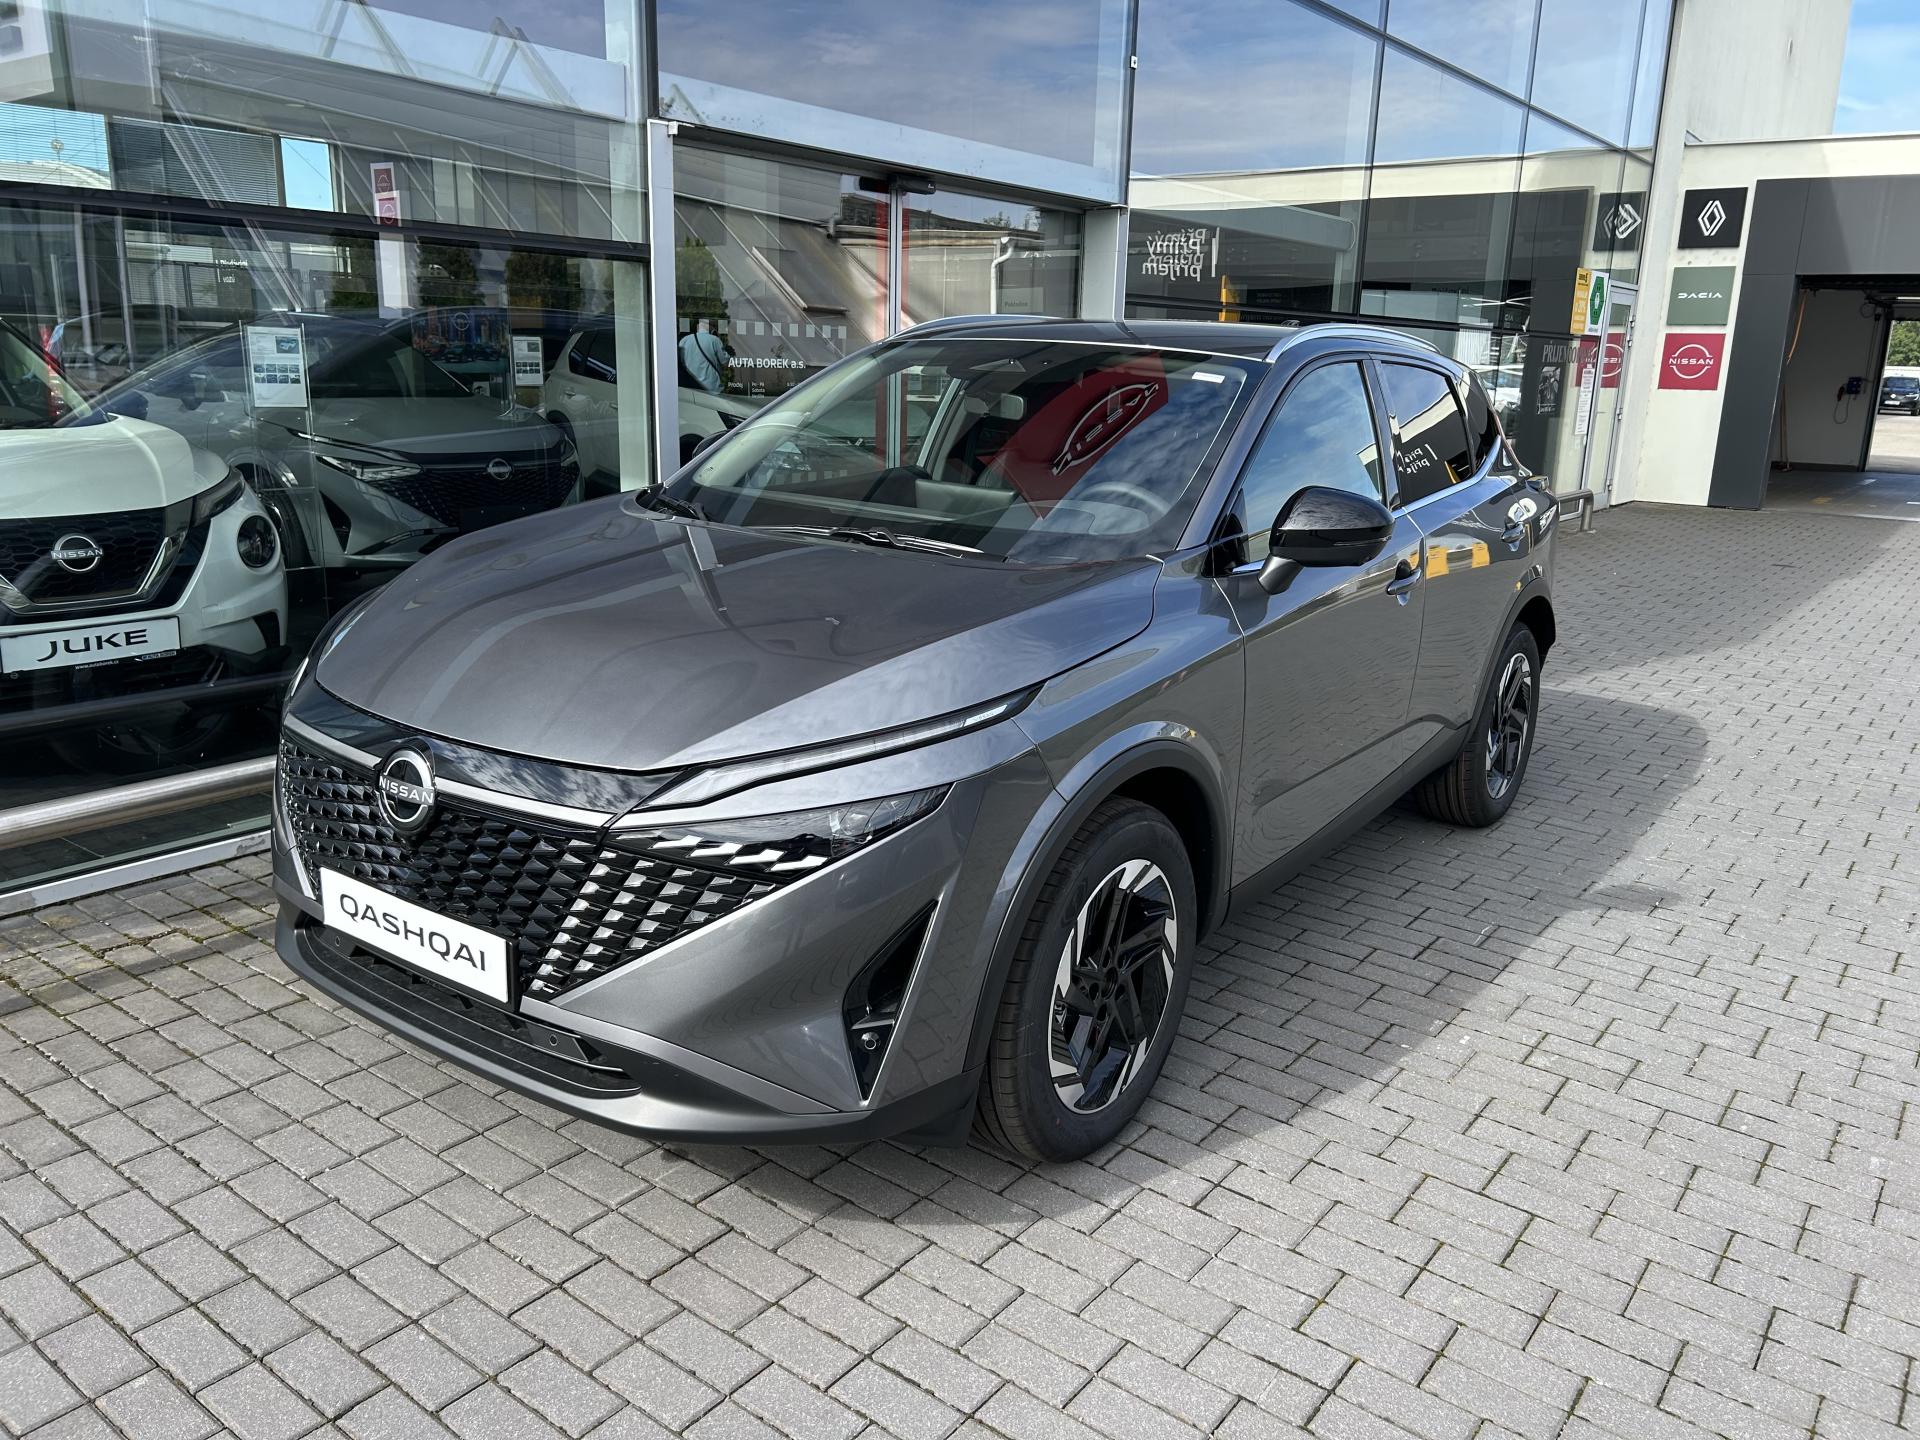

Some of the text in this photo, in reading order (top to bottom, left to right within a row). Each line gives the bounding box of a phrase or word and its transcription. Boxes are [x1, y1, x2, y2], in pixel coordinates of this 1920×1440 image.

[728, 357, 806, 369] AUTA BOREK a.s.
[52, 549, 103, 559] NISSAN
[36, 629, 148, 662] JUKE
[379, 775, 434, 804] NISSAN
[340, 893, 486, 972] QASHQAI
